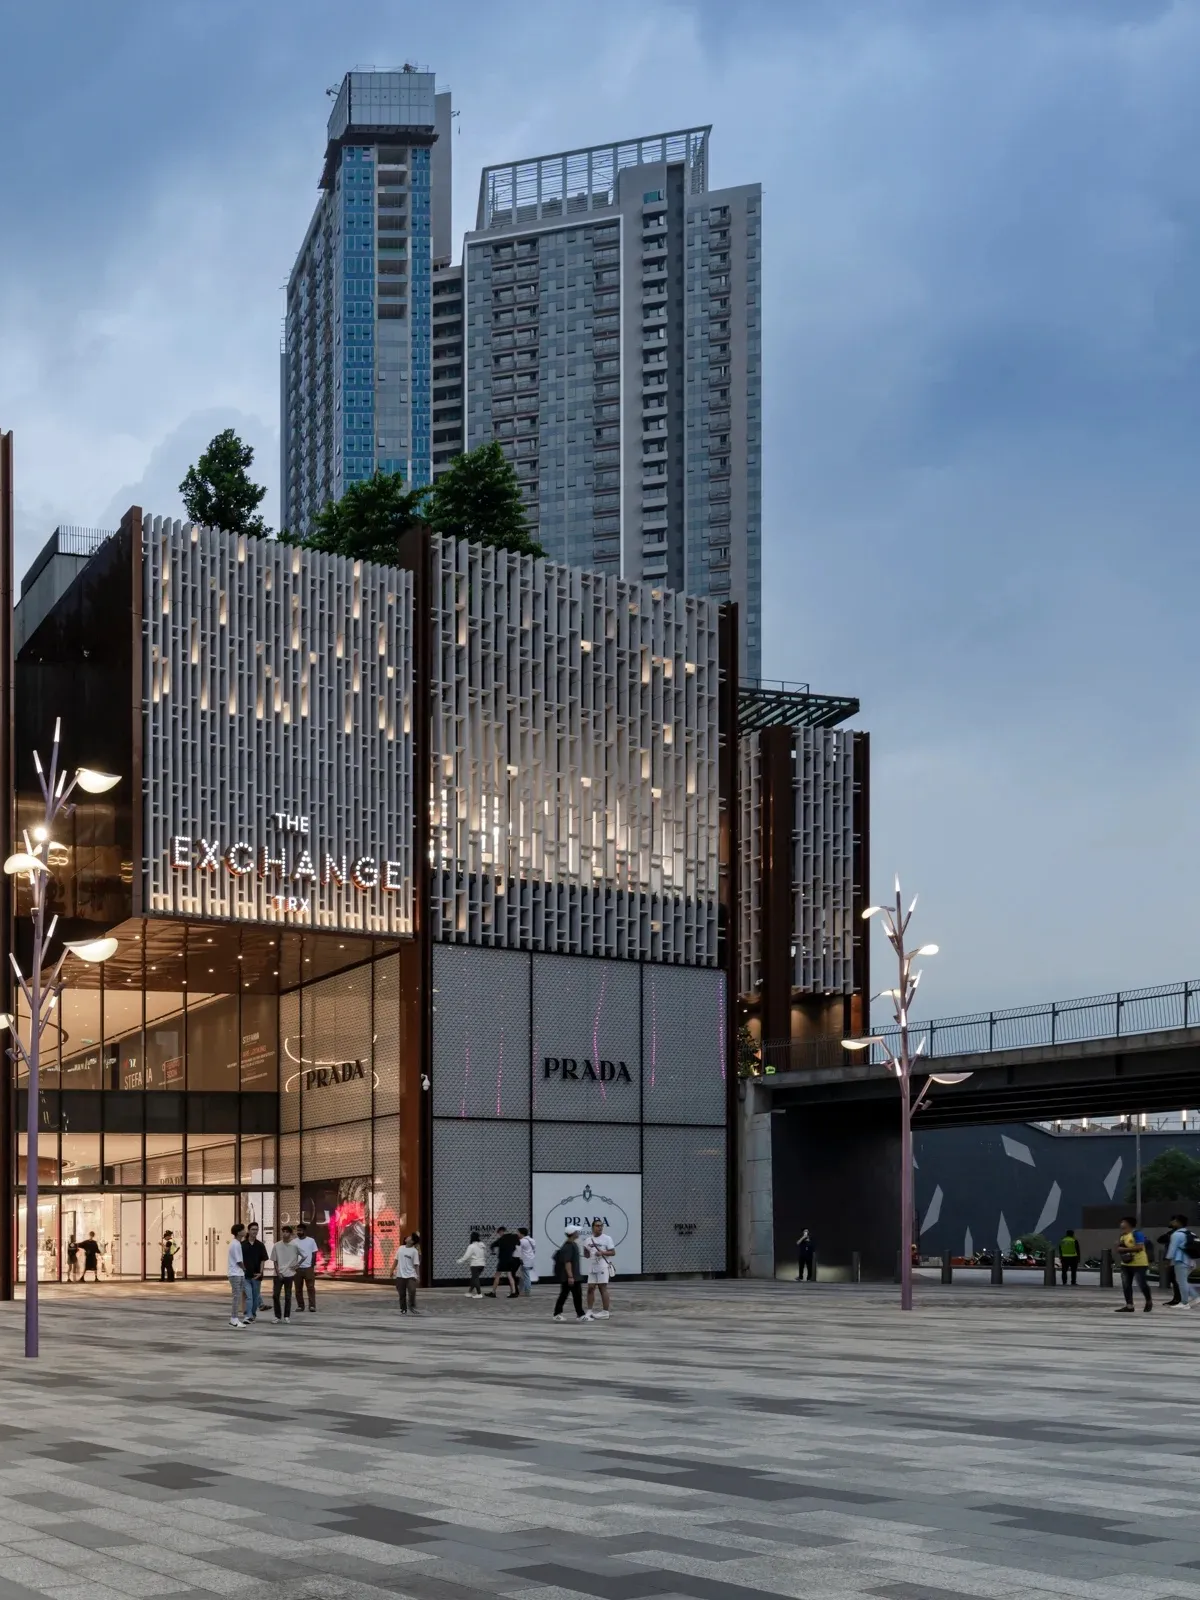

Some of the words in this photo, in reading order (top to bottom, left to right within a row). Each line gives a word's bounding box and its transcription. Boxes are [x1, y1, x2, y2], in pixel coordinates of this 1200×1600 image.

[275, 812, 309, 833] THE
[172, 835, 401, 891] EXCHANGE
[274, 896, 310, 912] TRX
[306, 1060, 364, 1090] PRADA
[544, 1057, 633, 1082] PRADA
